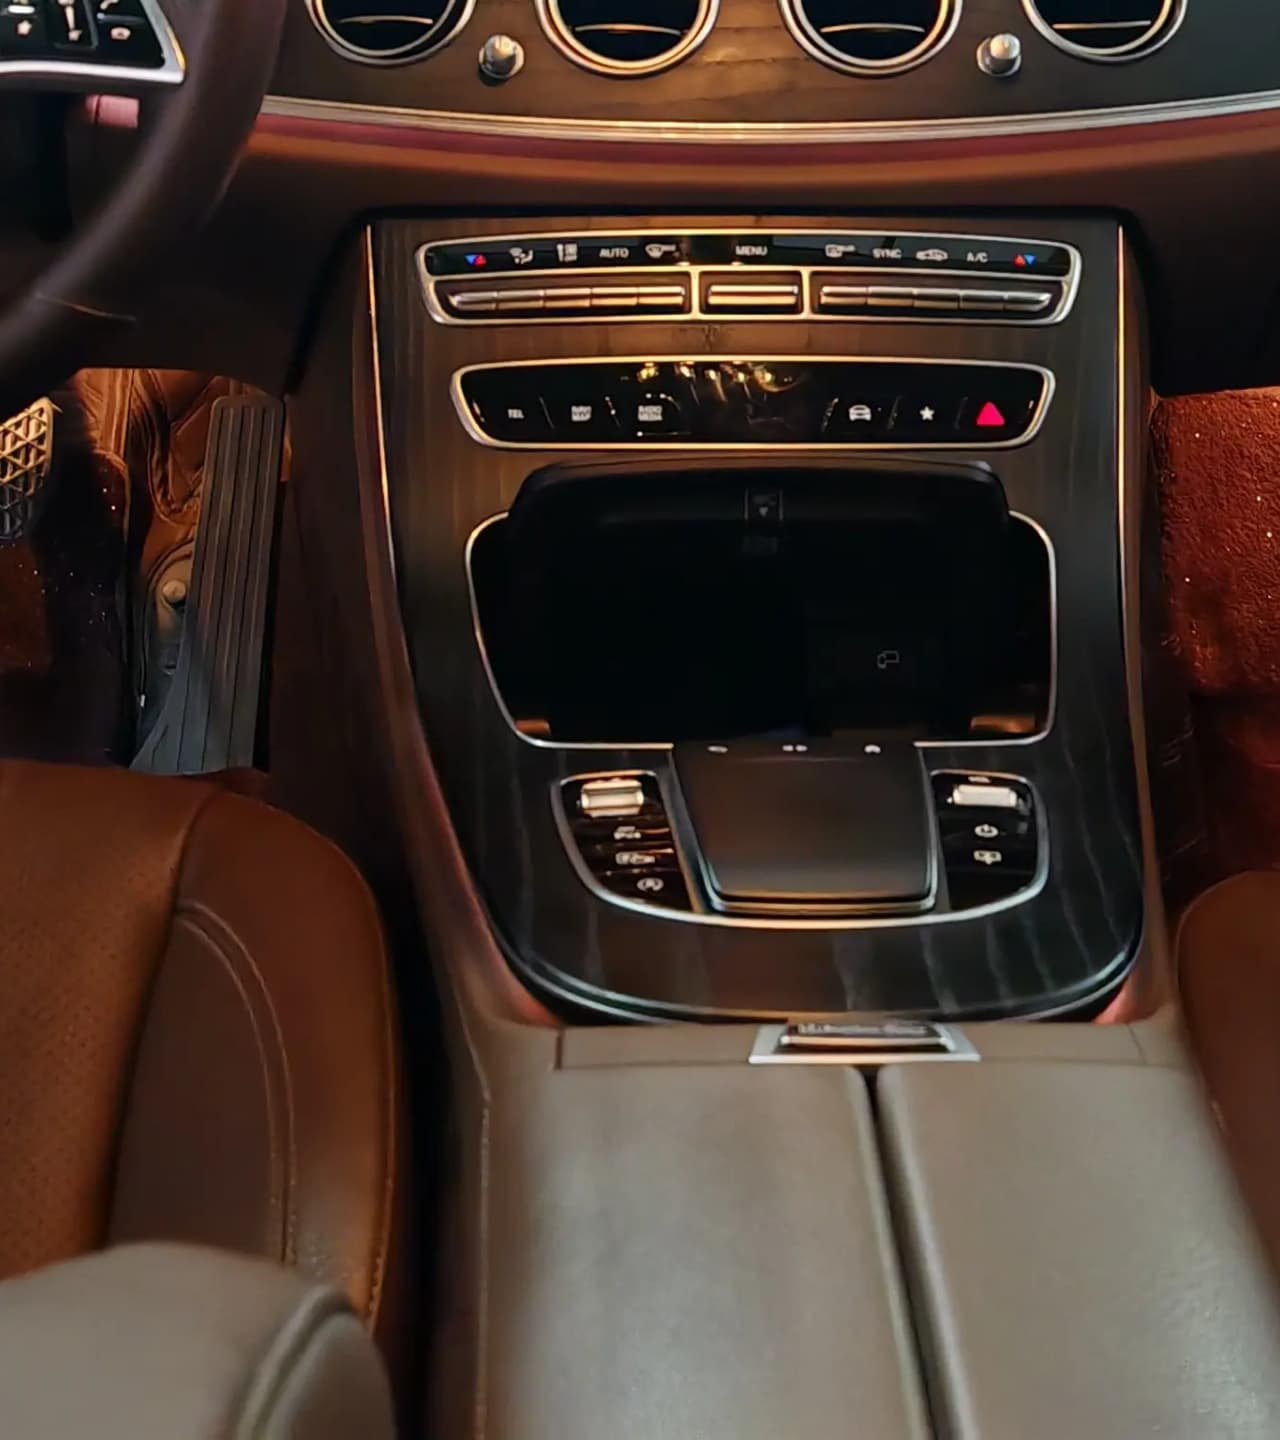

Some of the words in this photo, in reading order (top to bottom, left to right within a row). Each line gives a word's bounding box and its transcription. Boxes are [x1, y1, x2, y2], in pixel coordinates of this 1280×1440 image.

[599, 247, 629, 259] AUTO
[735, 245, 767, 257] MENU
[873, 249, 901, 260] SYNC
[967, 252, 988, 264] A/C
